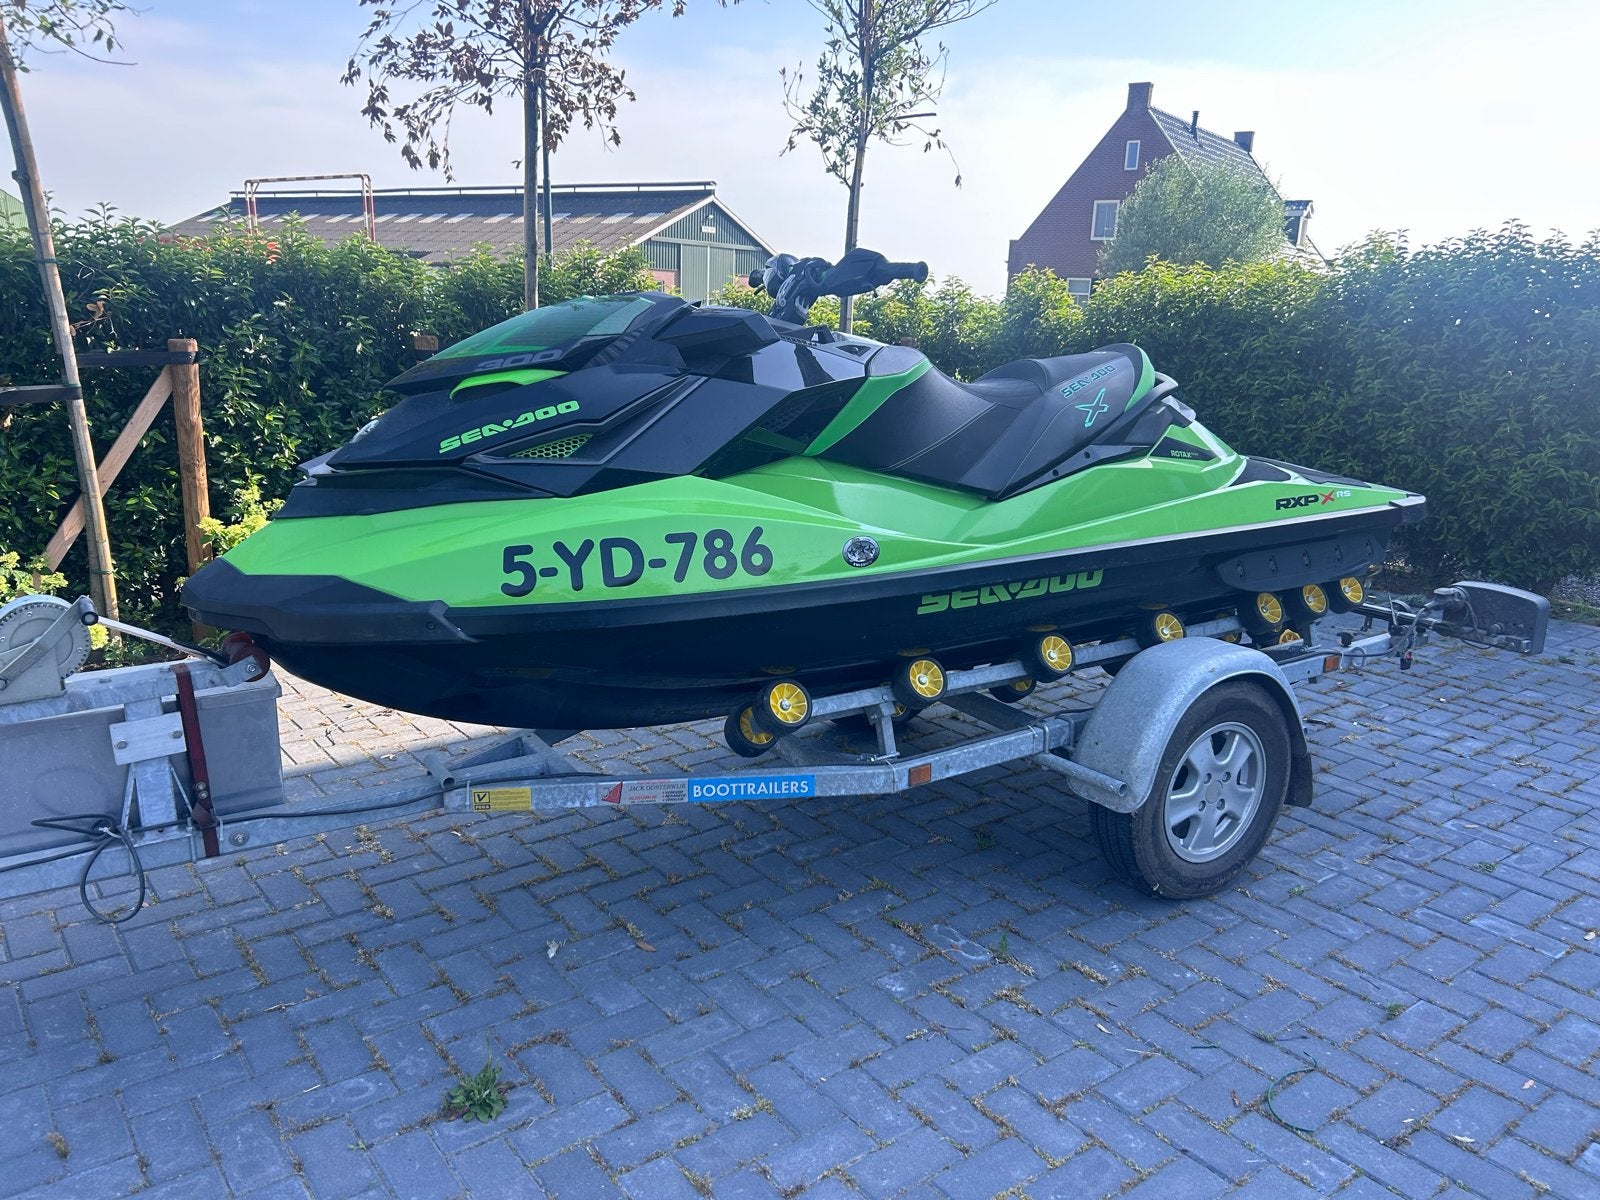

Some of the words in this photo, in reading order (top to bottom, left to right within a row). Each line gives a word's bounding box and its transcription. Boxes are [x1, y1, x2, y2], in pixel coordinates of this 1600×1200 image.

[475, 349, 562, 372] 300
[500, 525, 774, 598] 5-YD-786
[693, 779, 809, 799] BOOTTRAILERS
